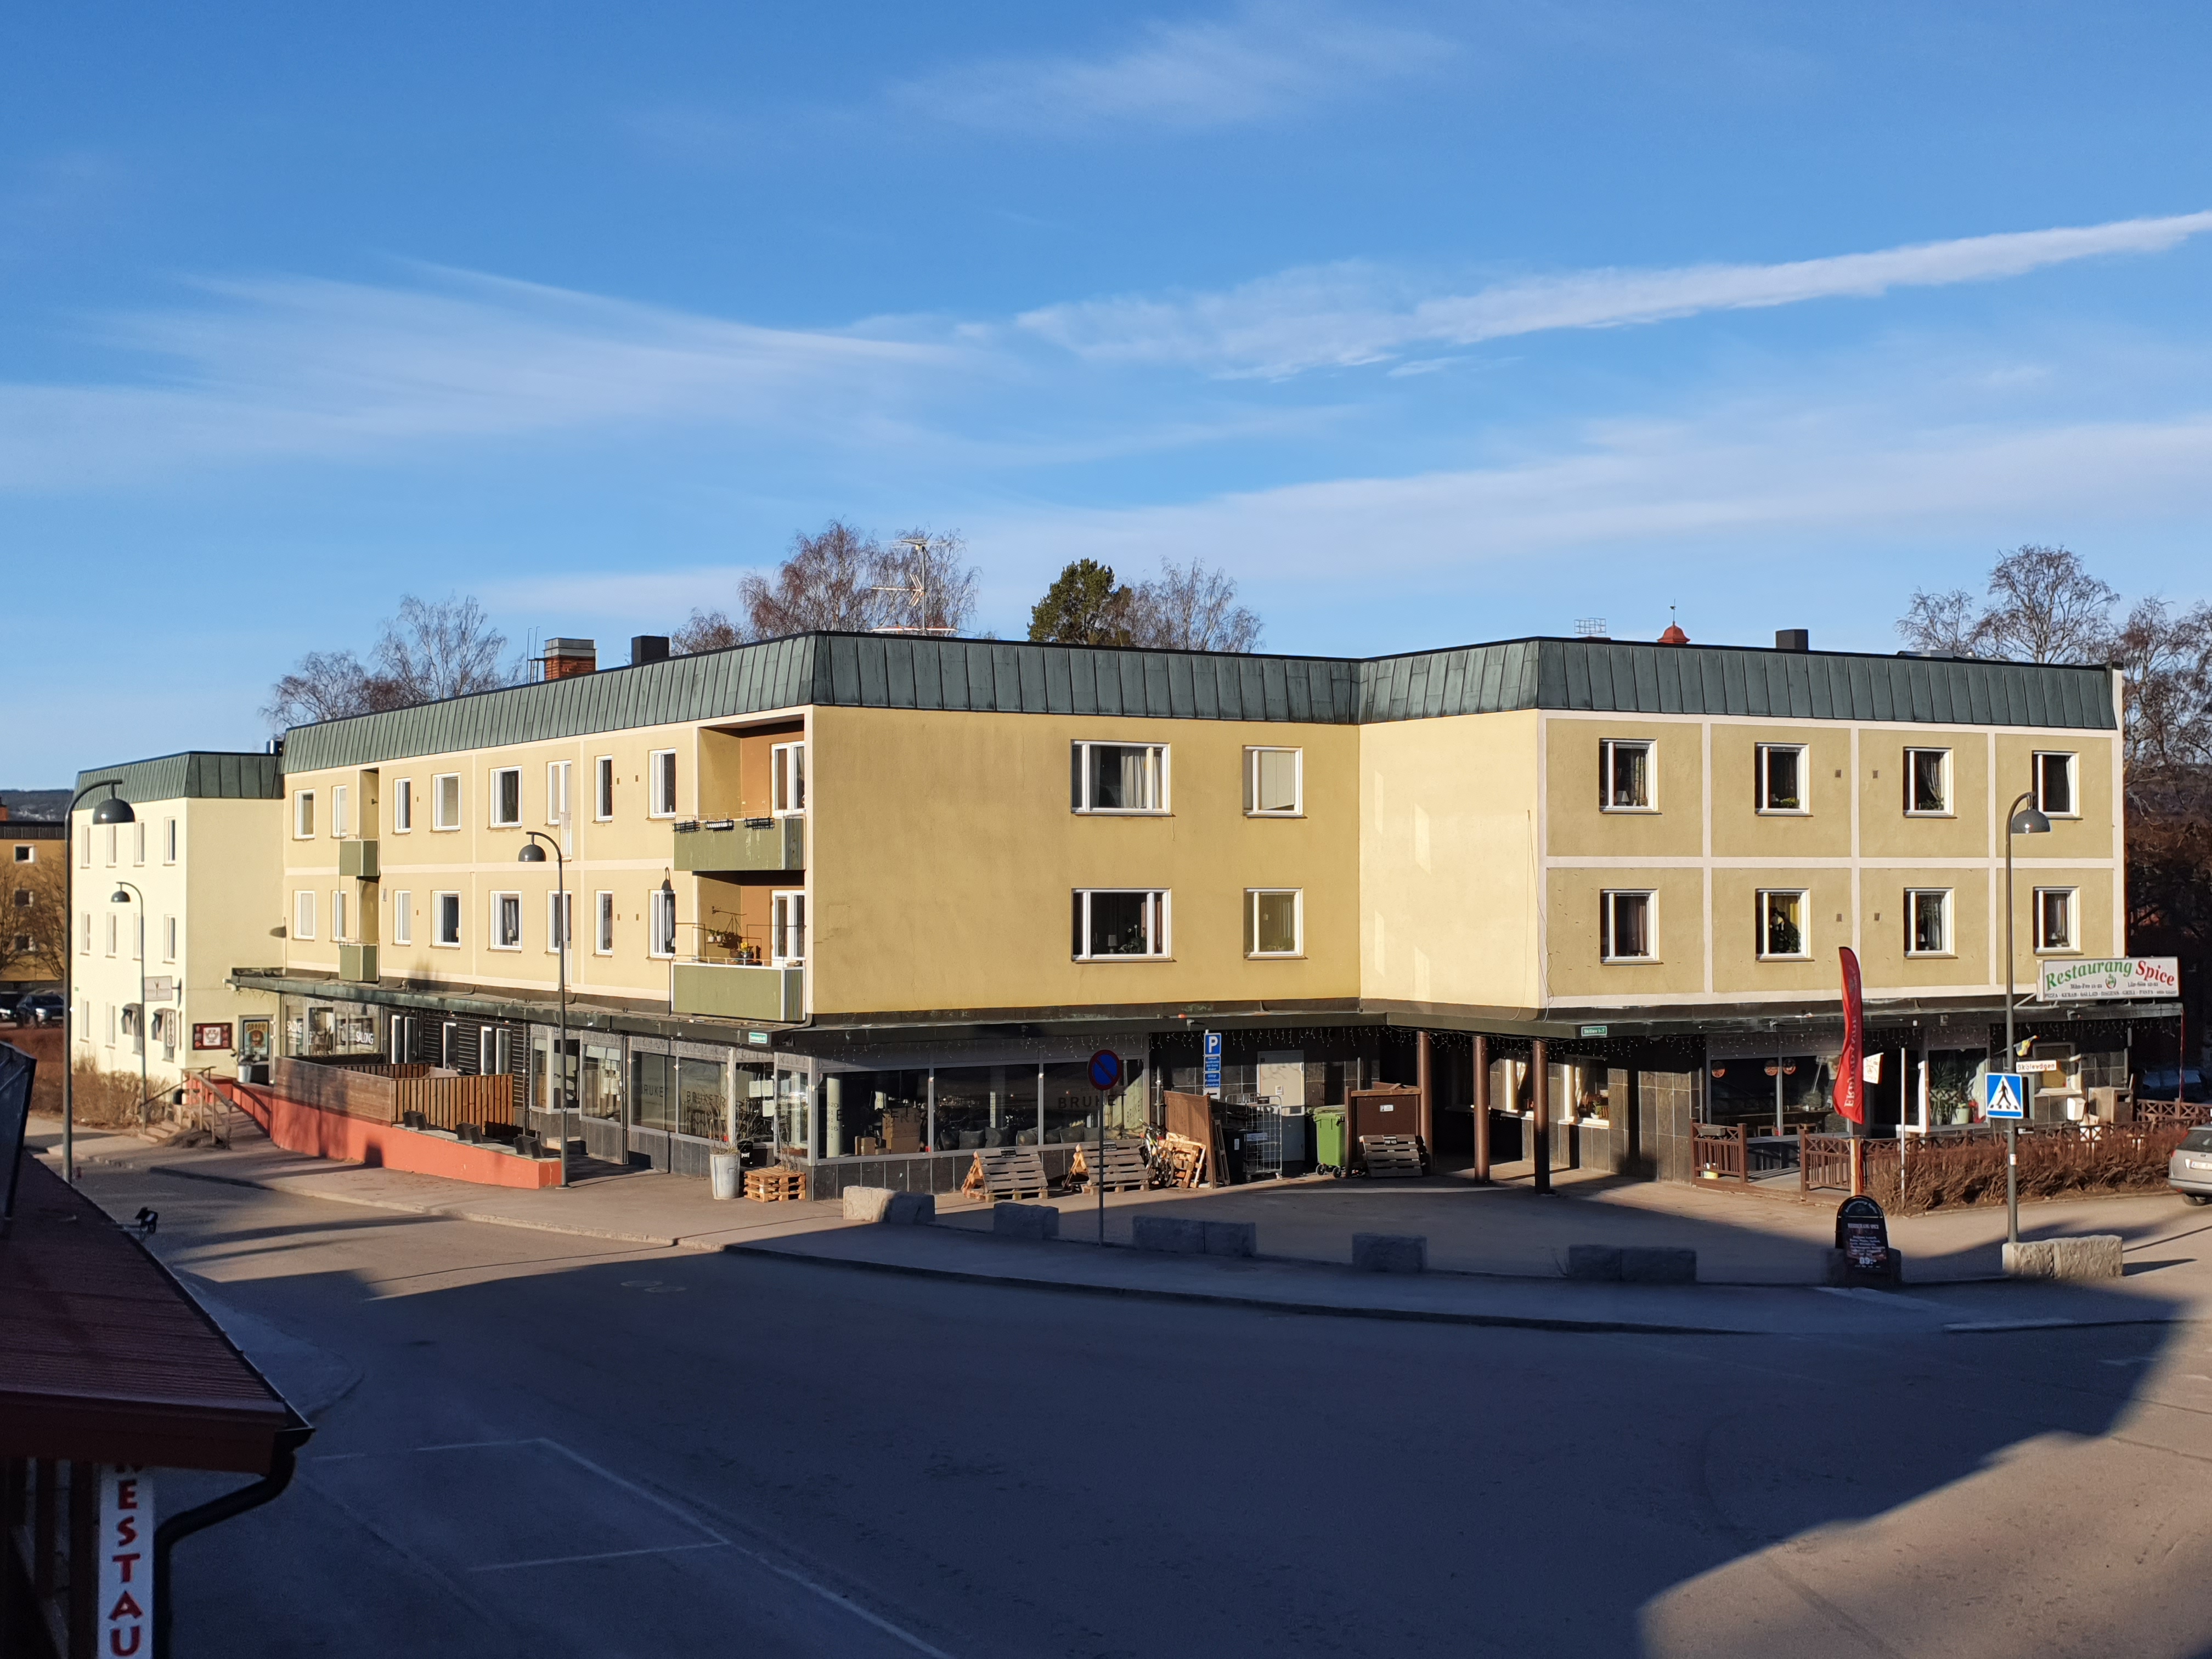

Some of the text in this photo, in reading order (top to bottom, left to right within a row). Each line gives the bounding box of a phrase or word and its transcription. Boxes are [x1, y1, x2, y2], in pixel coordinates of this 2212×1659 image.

[2046, 960, 2175, 992] Restaurang Spice
[356, 1031, 374, 1045] SALONG
[1209, 1036, 1218, 1053] P
[109, 1465, 143, 1657] ESTAU
